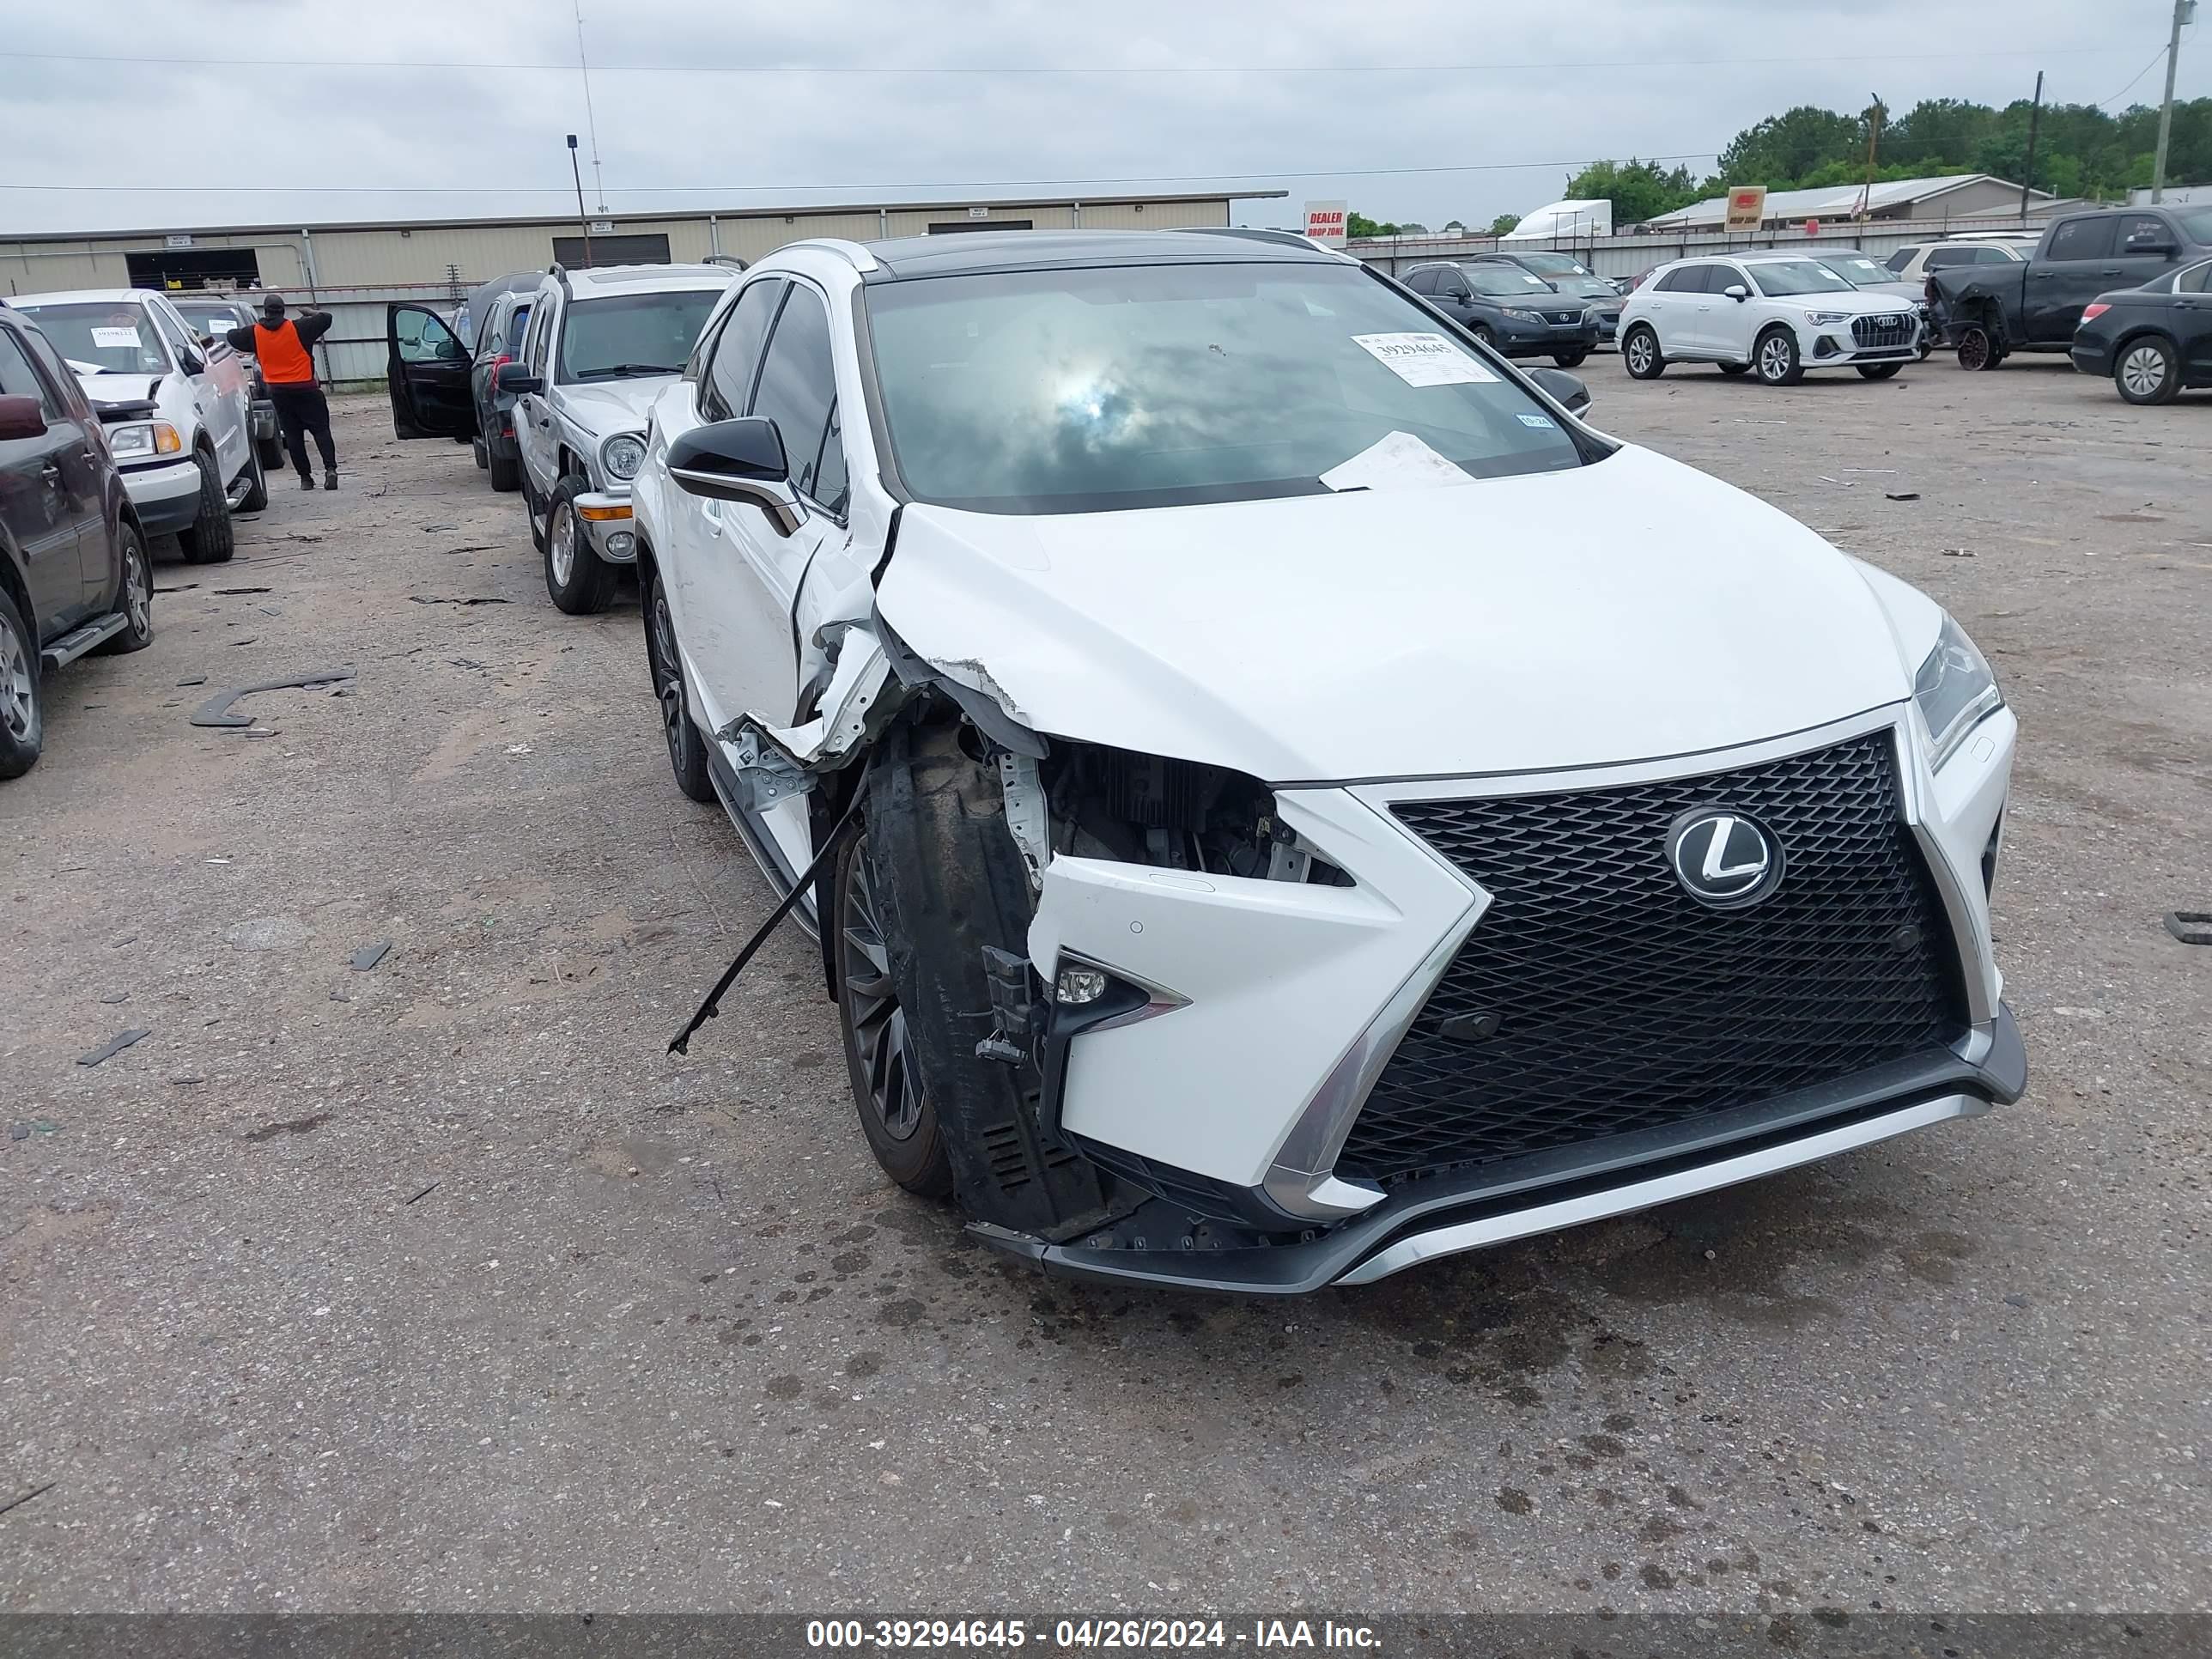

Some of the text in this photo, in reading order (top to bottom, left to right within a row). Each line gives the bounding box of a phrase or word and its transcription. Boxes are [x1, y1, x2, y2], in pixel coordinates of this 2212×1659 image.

[1310, 212, 1342, 224] DEALER
[1308, 227, 1344, 237] DROP ZONE
[1376, 343, 1452, 356] 39294645
